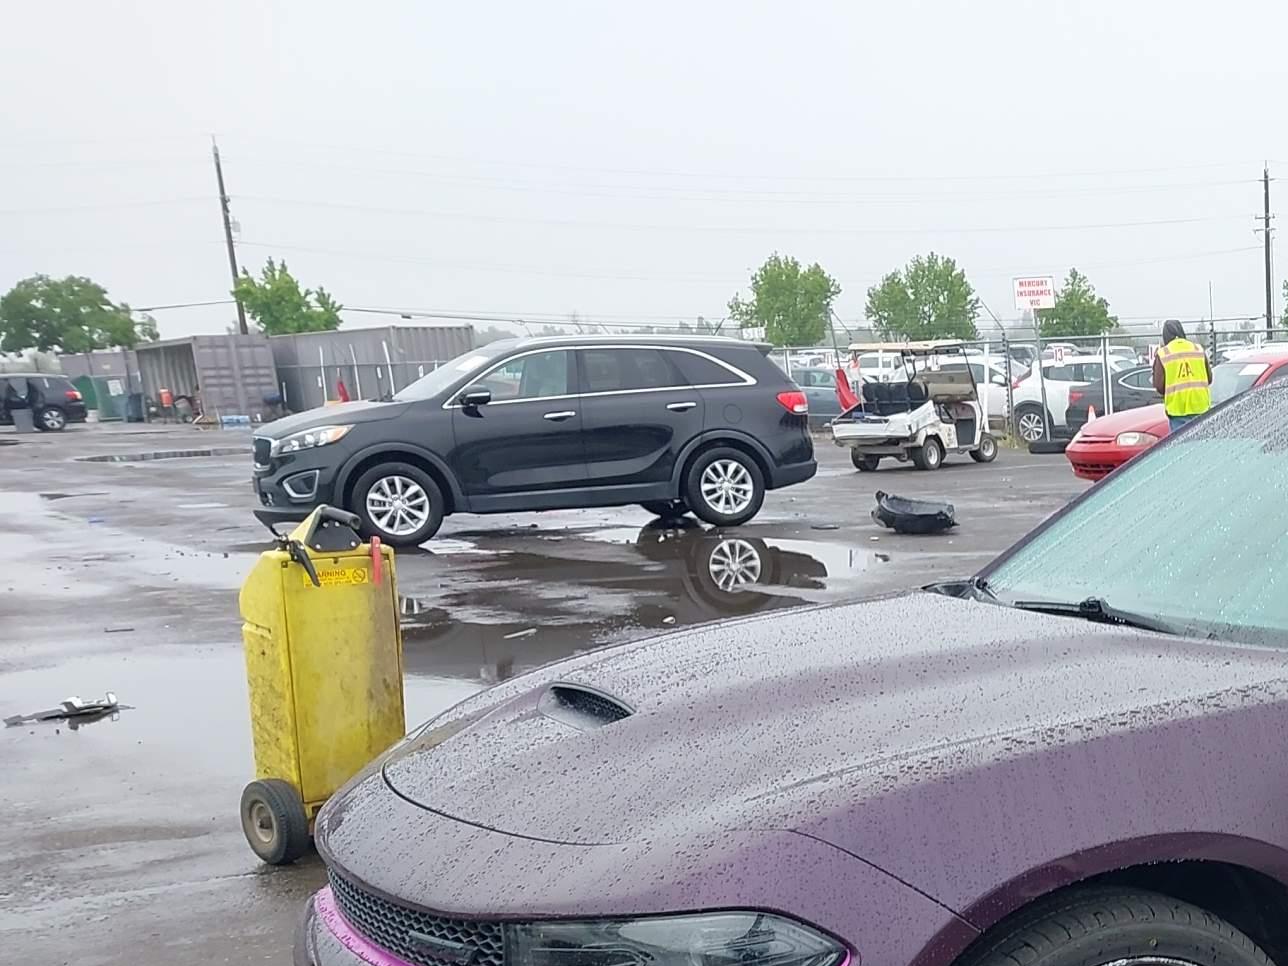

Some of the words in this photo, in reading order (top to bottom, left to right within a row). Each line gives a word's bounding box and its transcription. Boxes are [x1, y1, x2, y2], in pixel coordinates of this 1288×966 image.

[1018, 279, 1048, 288] MERCURY
[1016, 288, 1052, 297] INSURANCE
[1054, 348, 1064, 362] 13
